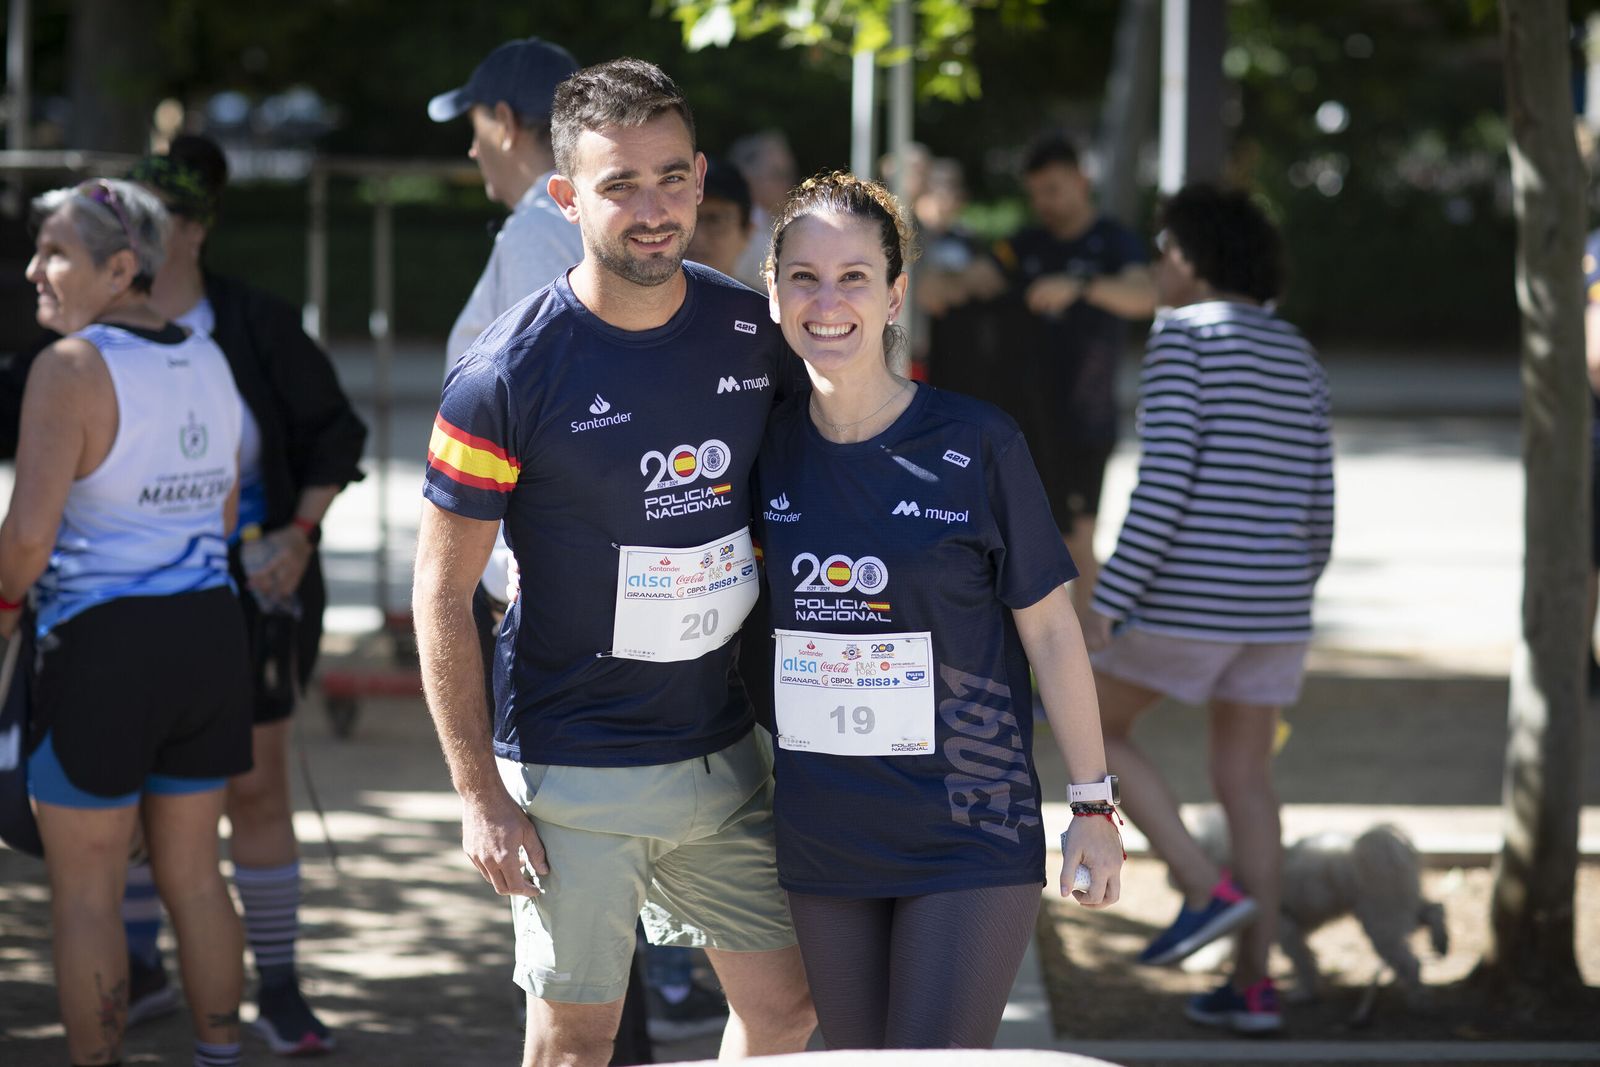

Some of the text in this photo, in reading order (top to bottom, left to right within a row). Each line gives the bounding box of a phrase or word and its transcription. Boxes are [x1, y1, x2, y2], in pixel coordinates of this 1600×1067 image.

[742, 373, 770, 391] mupol
[570, 412, 632, 433] Santander
[640, 439, 731, 492] 200
[946, 453, 968, 465] 42K
[644, 486, 715, 509] POLICIA
[646, 496, 731, 520] NACIONAL
[925, 508, 969, 524] mupol
[763, 510, 802, 523] ntander
[628, 573, 671, 588] alsa
[791, 552, 888, 595] 200
[687, 585, 707, 594] CBPOL
[794, 598, 871, 610] POLICIA
[795, 610, 892, 622] NACIONAL
[680, 609, 719, 641] 20
[798, 649, 823, 657] Santander
[783, 657, 817, 673] alsa
[782, 676, 820, 685] GRANAPOL
[831, 677, 854, 685] CBPOL
[830, 705, 876, 735] 19
